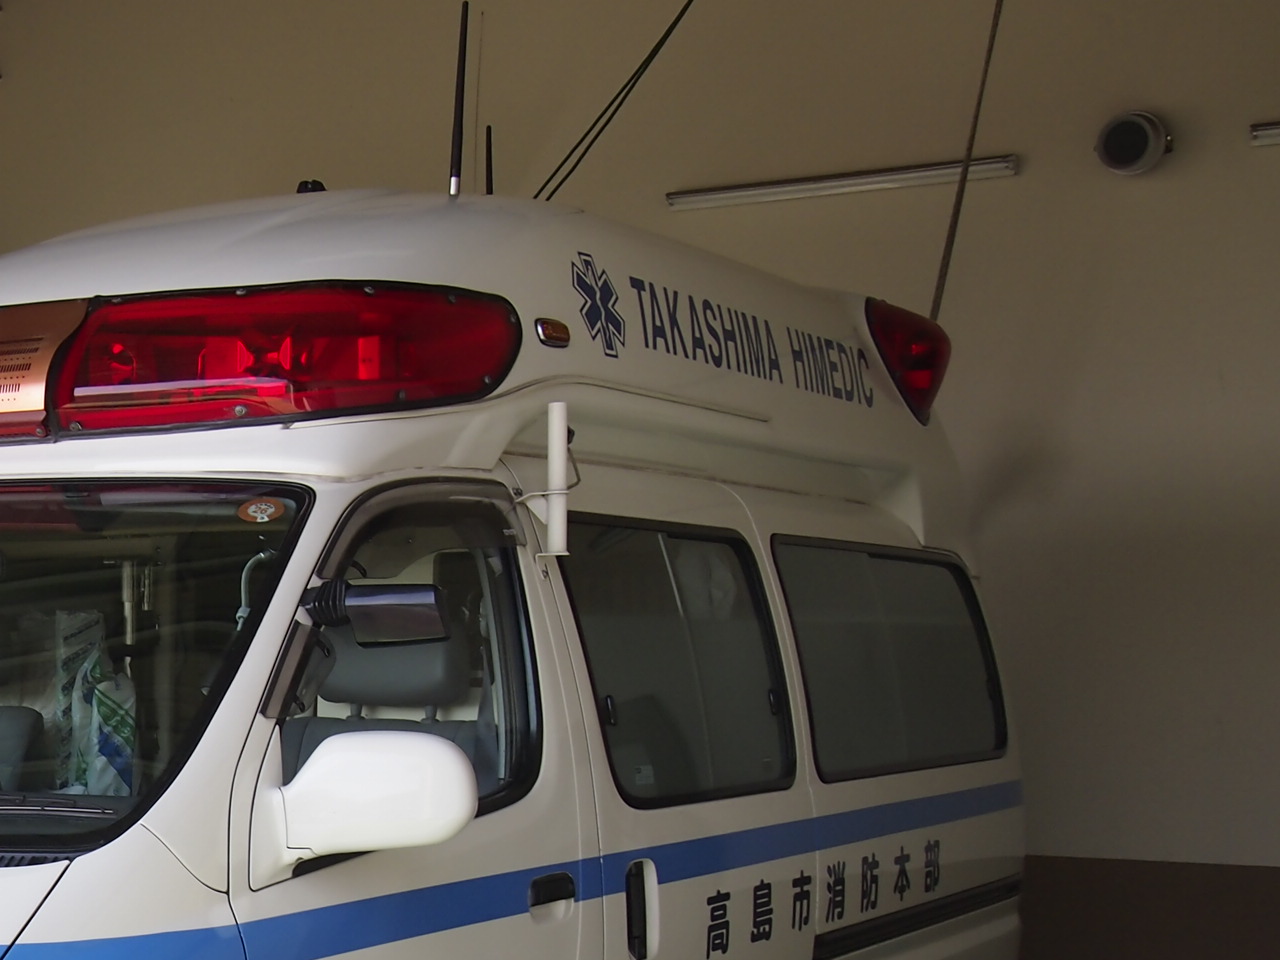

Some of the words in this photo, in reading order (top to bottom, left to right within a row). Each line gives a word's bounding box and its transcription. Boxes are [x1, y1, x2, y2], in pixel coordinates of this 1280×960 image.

[629, 276, 783, 384] TAKASHIMA
[786, 326, 874, 408] HIMEDIC
[706, 839, 941, 960] 高島市消防本部
